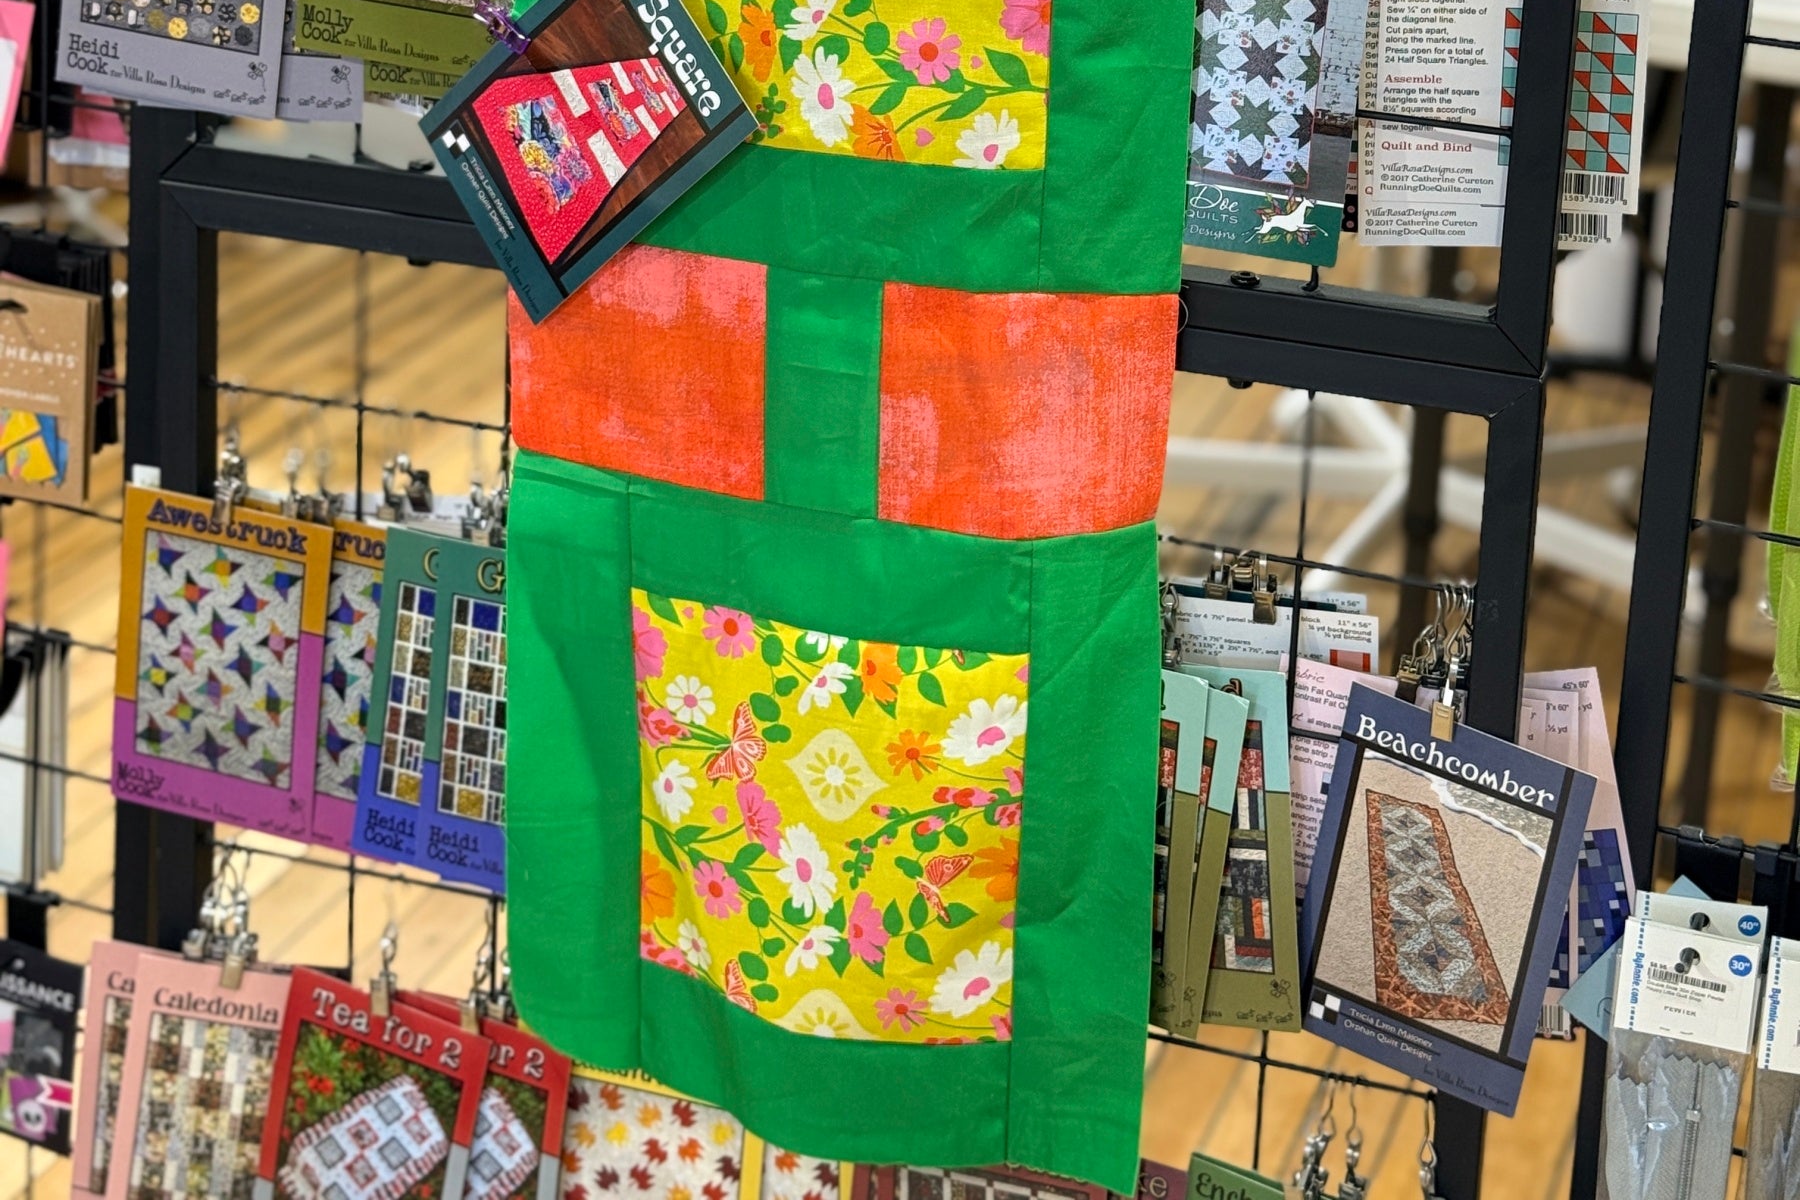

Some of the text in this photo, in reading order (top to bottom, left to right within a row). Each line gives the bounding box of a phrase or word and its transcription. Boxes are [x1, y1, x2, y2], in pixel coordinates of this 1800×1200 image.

[1433, 6, 1457, 14] either
[303, 4, 354, 33] Molly
[1402, 16, 1436, 25] diagonal
[1402, 27, 1422, 36] pairs
[69, 33, 120, 60] Heidi
[302, 22, 440, 62] Cook for Villa Rosa Designs
[1386, 36, 1408, 44] along
[1385, 47, 1472, 57] Press open total
[1416, 56, 1488, 66] Square Triangles.
[67, 52, 206, 95] Cook for Villa Rosa Designs
[370, 64, 413, 84] Cook
[1384, 74, 1442, 84] Assemble
[1384, 87, 1480, 97] Arrange square
[1383, 96, 1418, 105] triangles
[1400, 106, 1476, 116] squares according
[1382, 141, 1472, 152] Quilt and Bind
[1380, 164, 1473, 176] VillaRosaDesigns.com
[1412, 174, 1494, 185] Catherine Cureton
[1380, 184, 1482, 194] RunningDoeQuilts.com
[1190, 184, 1240, 214] Doe
[1185, 210, 1238, 224] QUILTS
[1366, 207, 1457, 220] VillaRosaDesigns.com
[1396, 218, 1478, 228] Catherine Cureton
[1190, 224, 1236, 241] Designs
[1365, 228, 1466, 237] RunningDoeQuilts.com
[147, 499, 308, 555] Awestruck
[1311, 685, 1324, 696] Fat
[1323, 698, 1337, 708] Fat
[1312, 748, 1328, 758] strip
[1356, 714, 1554, 807] Beachcomber
[366, 808, 416, 838] Heidi
[364, 824, 404, 852] Cook
[429, 825, 480, 853] Heidi
[427, 842, 468, 868] Cook
[1740, 920, 1759, 930] 40"
[1731, 960, 1750, 972] 30"
[1630, 952, 1645, 1004] ByAnnie.com
[153, 987, 280, 1025] Caledonia
[1766, 987, 1782, 1042] ByAnnie.com
[313, 988, 463, 1070] Tea for 2
[1350, 1008, 1433, 1048] Tricia Lynn Maloney
[1344, 1020, 1432, 1062] Orphan Quilt Designs
[523, 1048, 546, 1079] 2
